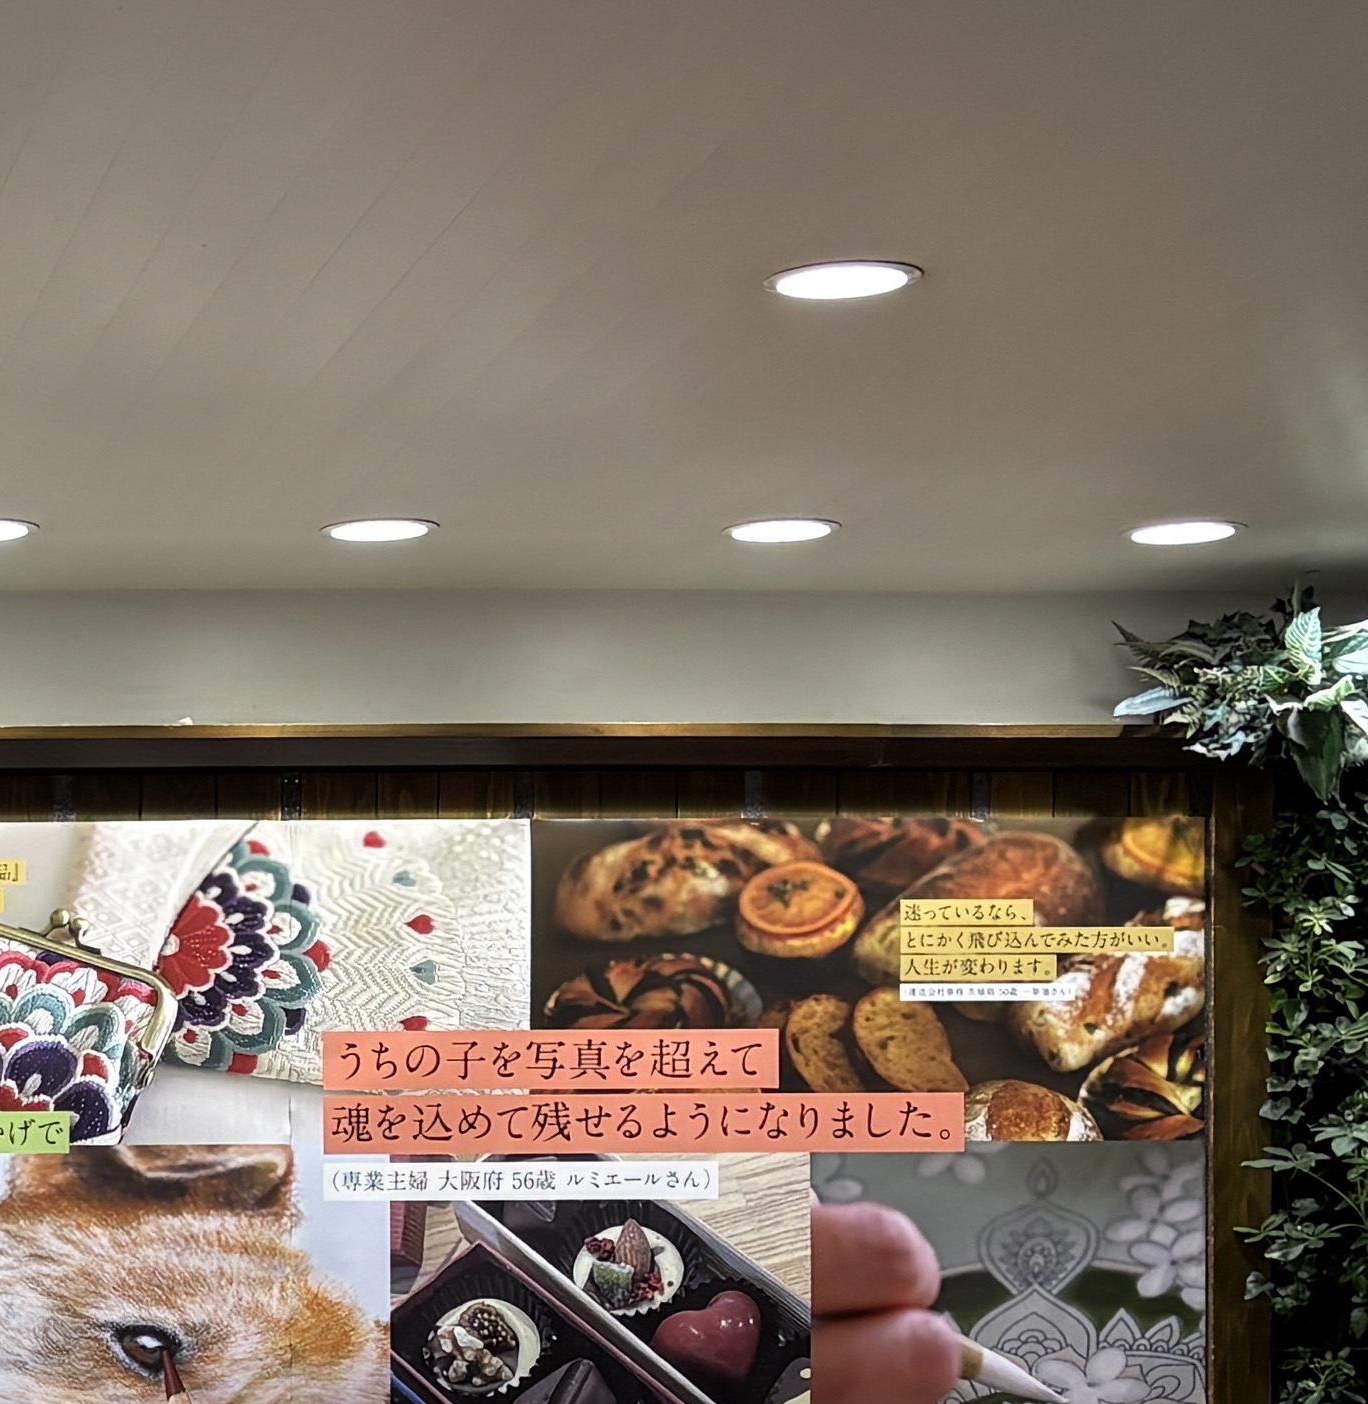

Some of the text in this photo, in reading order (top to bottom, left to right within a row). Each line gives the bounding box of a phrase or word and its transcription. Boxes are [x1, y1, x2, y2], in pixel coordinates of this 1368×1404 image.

[904, 905, 1027, 921] 迷っているなら、
[907, 931, 1168, 949] とにかく飛び込んでみた方がいい。
[907, 958, 1051, 976] 人生が変わります。
[341, 1039, 763, 1080] うちの子を写真を超えて
[332, 1102, 951, 1143] 魂を込めて残せるようになりました。
[438, 1170, 504, 1193] 大阪府
[512, 1170, 556, 1192] 56歳
